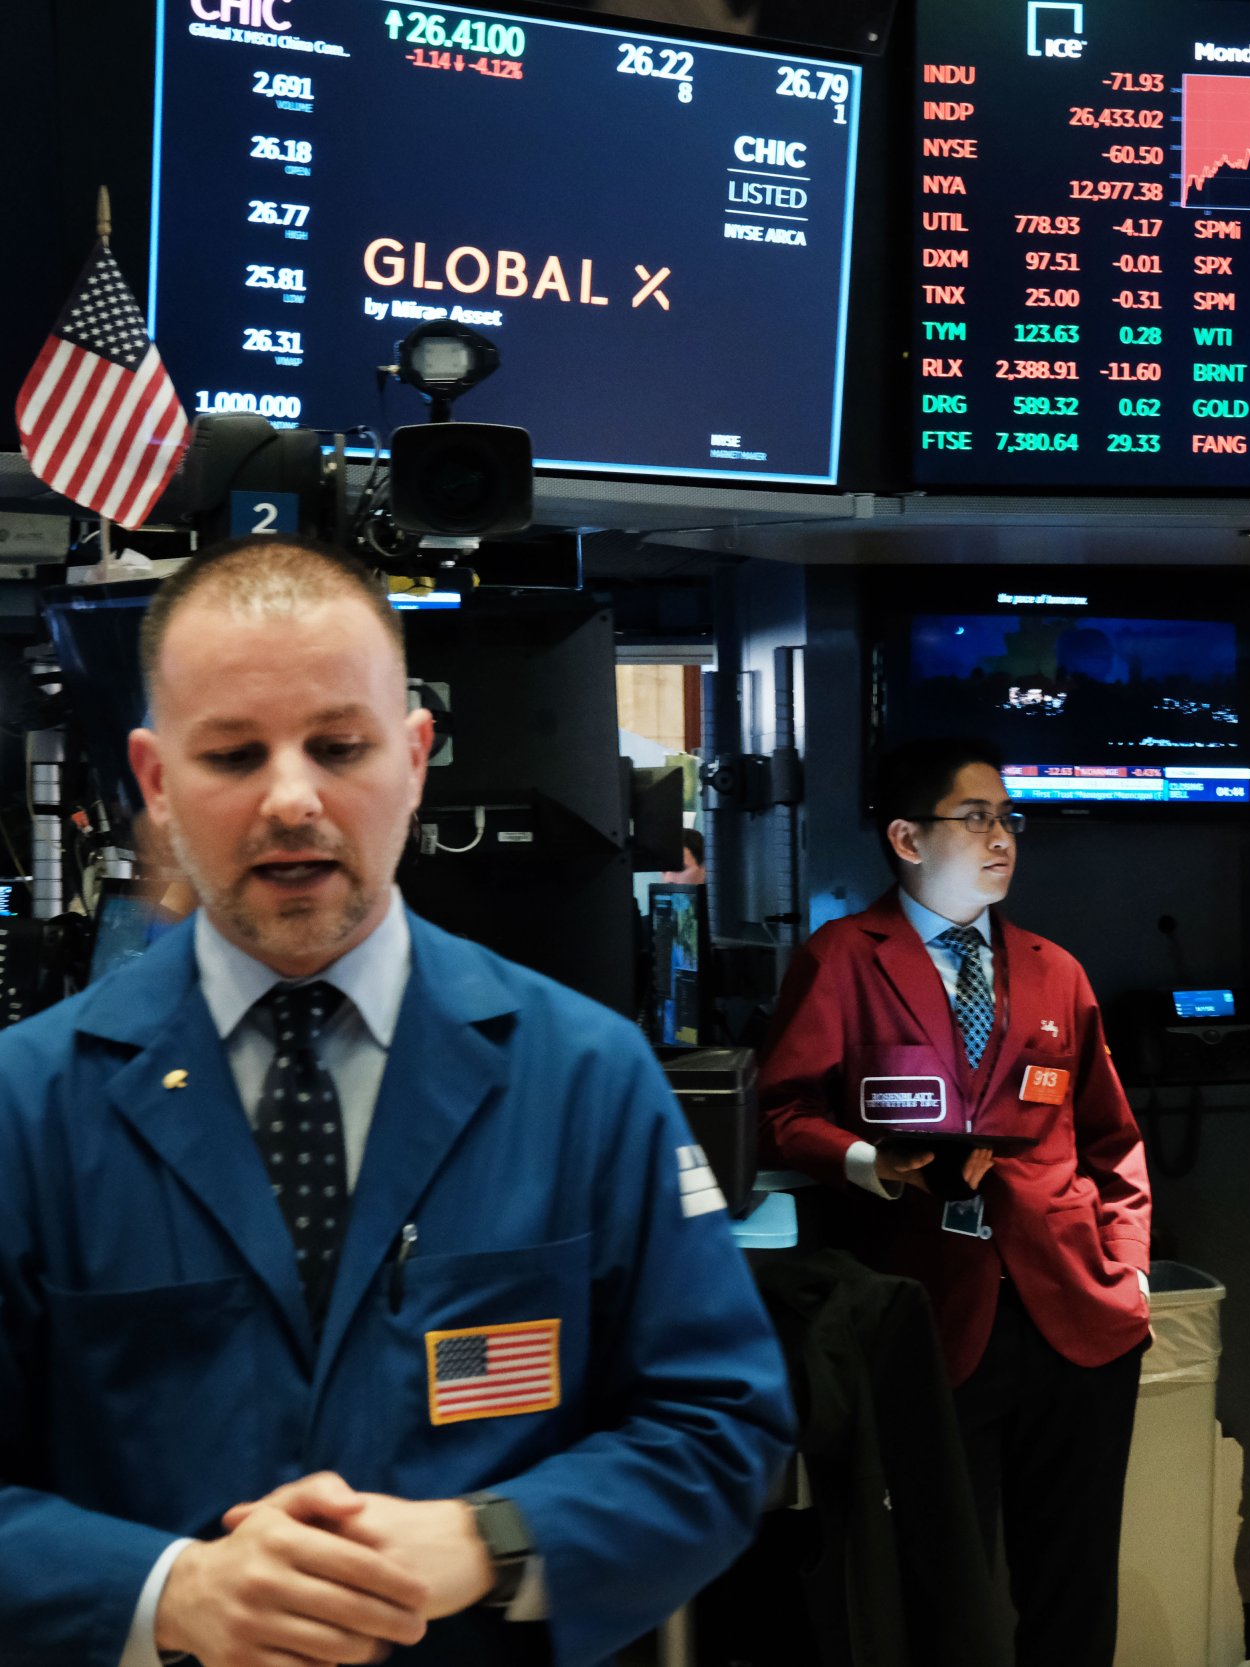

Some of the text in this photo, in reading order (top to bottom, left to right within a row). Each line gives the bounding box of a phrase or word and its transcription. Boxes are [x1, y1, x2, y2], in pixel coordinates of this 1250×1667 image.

[406, 12, 525, 57] 26.4100
[405, 49, 451, 69] -1.14
[617, 43, 694, 82] 26.22
[253, 71, 314, 99] 2,691
[776, 66, 849, 103] 26.79
[924, 65, 1164, 92] INDU -71.93
[678, 82, 692, 103] 8
[833, 104, 847, 124] 1
[924, 101, 1163, 128] INDP 26,433.02
[250, 135, 312, 163] 26.18
[734, 135, 807, 168] CHIC
[924, 139, 1163, 164] NYSE -60.50
[729, 181, 807, 208] LISTED
[923, 176, 1163, 201] NYA 12,977.38
[248, 200, 310, 226] 26.77
[923, 212, 1162, 236] UTIL 778.93 -4.17
[724, 223, 807, 246] NYSE ARCA
[923, 249, 1162, 273] DXM 97.51 -0.01
[1194, 256, 1232, 274] SPX
[246, 264, 306, 291] 25.81
[363, 238, 670, 310] GLOBAL X
[922, 285, 1162, 309] TNX 25.00 -0.31
[1194, 292, 1235, 310] SPM
[364, 297, 502, 326] by Mirae Asset
[243, 328, 303, 353] 26.31
[922, 322, 1162, 344] TYM 123.63 0.28
[1194, 328, 1232, 346] WTI
[923, 359, 1161, 381] RLX 2,388.91 -11.60
[1194, 364, 1247, 382] BRNT
[923, 395, 1160, 416] DRG 589.32 0.62
[1193, 399, 1249, 417] GOLD
[923, 431, 1160, 452] FTSE 7,380.64 29.33
[1193, 435, 1246, 453] FANG
[251, 503, 278, 534] 2
[1033, 1070, 1058, 1088] 913
